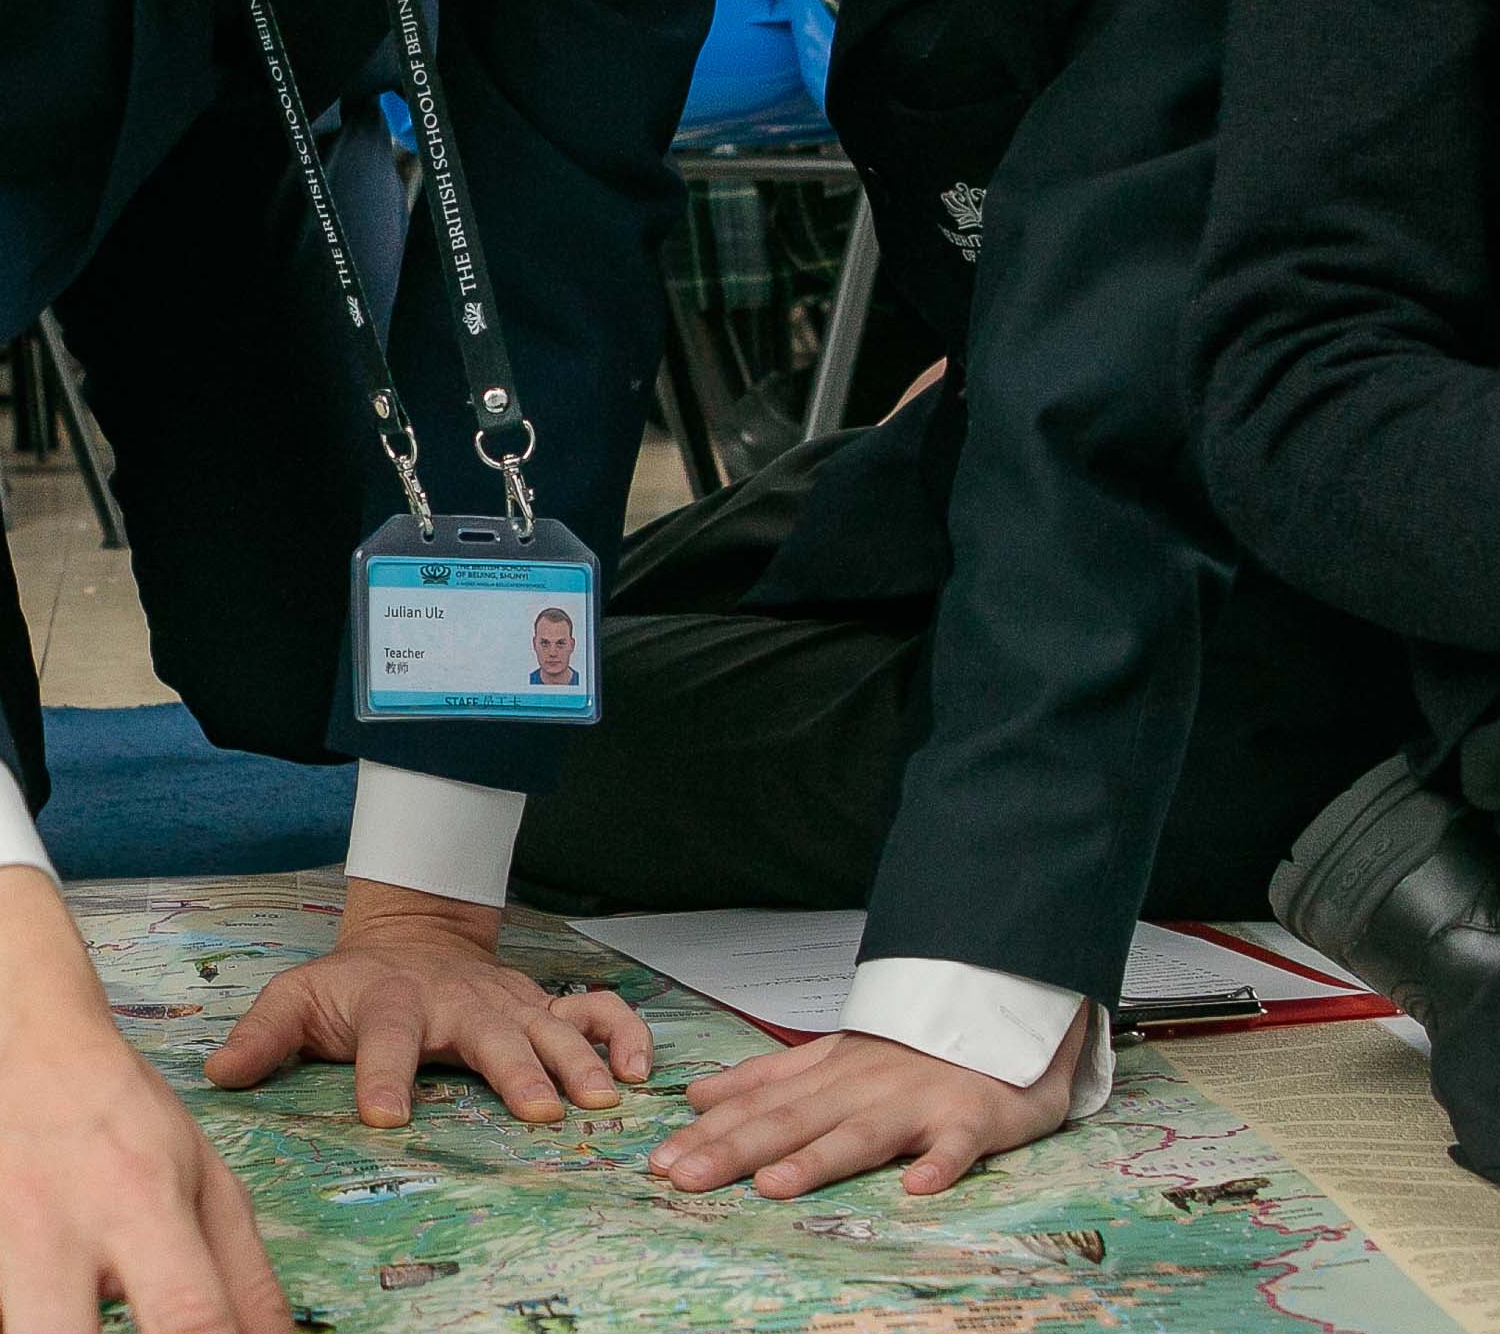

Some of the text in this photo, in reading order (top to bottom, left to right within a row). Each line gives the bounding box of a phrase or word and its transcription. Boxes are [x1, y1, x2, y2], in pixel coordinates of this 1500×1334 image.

[410, 60, 428, 85] OF
[277, 81, 312, 164] SCHOOL
[417, 85, 448, 169] SCHOOL
[305, 169, 338, 243] BRITISH
[436, 171, 468, 250] BRITISH
[331, 247, 352, 288] THE
[454, 252, 477, 295] THE
[384, 605, 445, 619] Julian Ulz
[384, 647, 425, 659] Teacher
